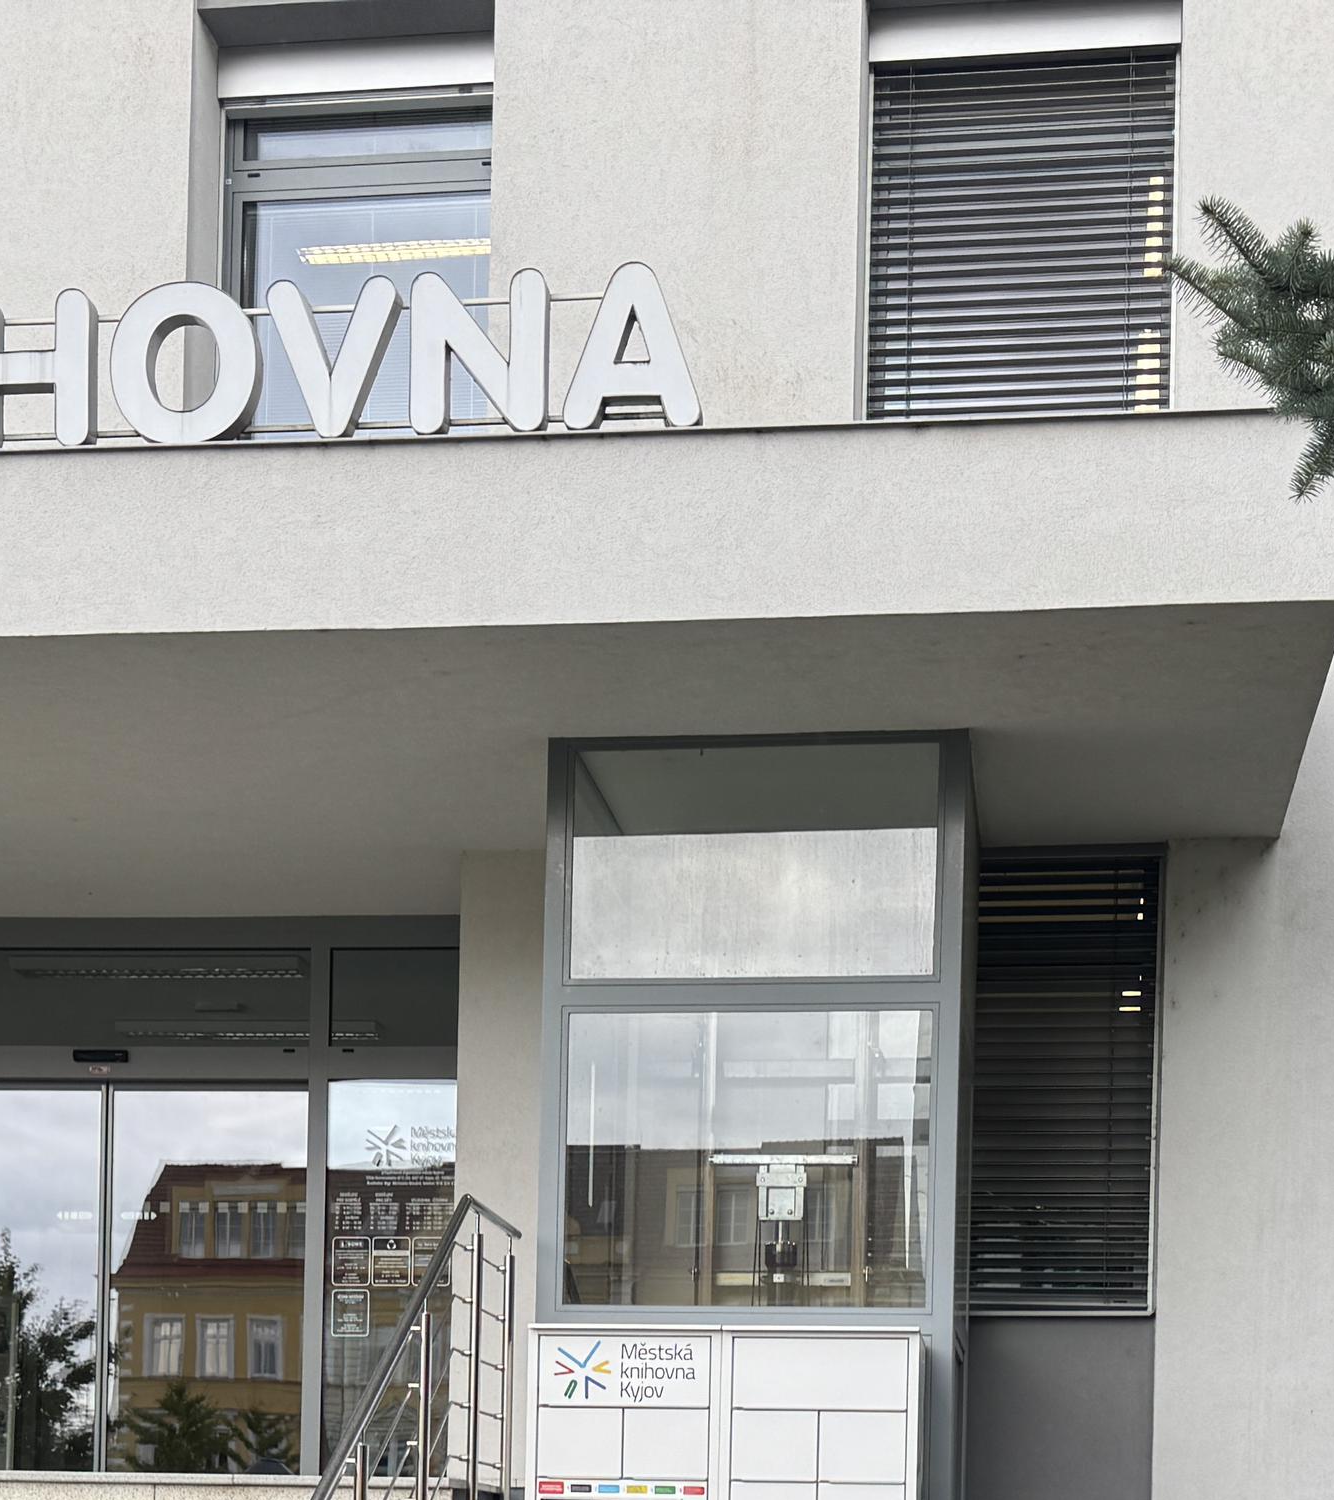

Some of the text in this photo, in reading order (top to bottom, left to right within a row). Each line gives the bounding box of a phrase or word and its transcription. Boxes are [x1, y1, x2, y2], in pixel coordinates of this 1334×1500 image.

[410, 1126, 455, 1138] Městsk
[410, 1140, 455, 1153] knihovn
[620, 1342, 694, 1361] Městská
[620, 1362, 696, 1380] knihovna
[620, 1381, 665, 1403] Kyjov
